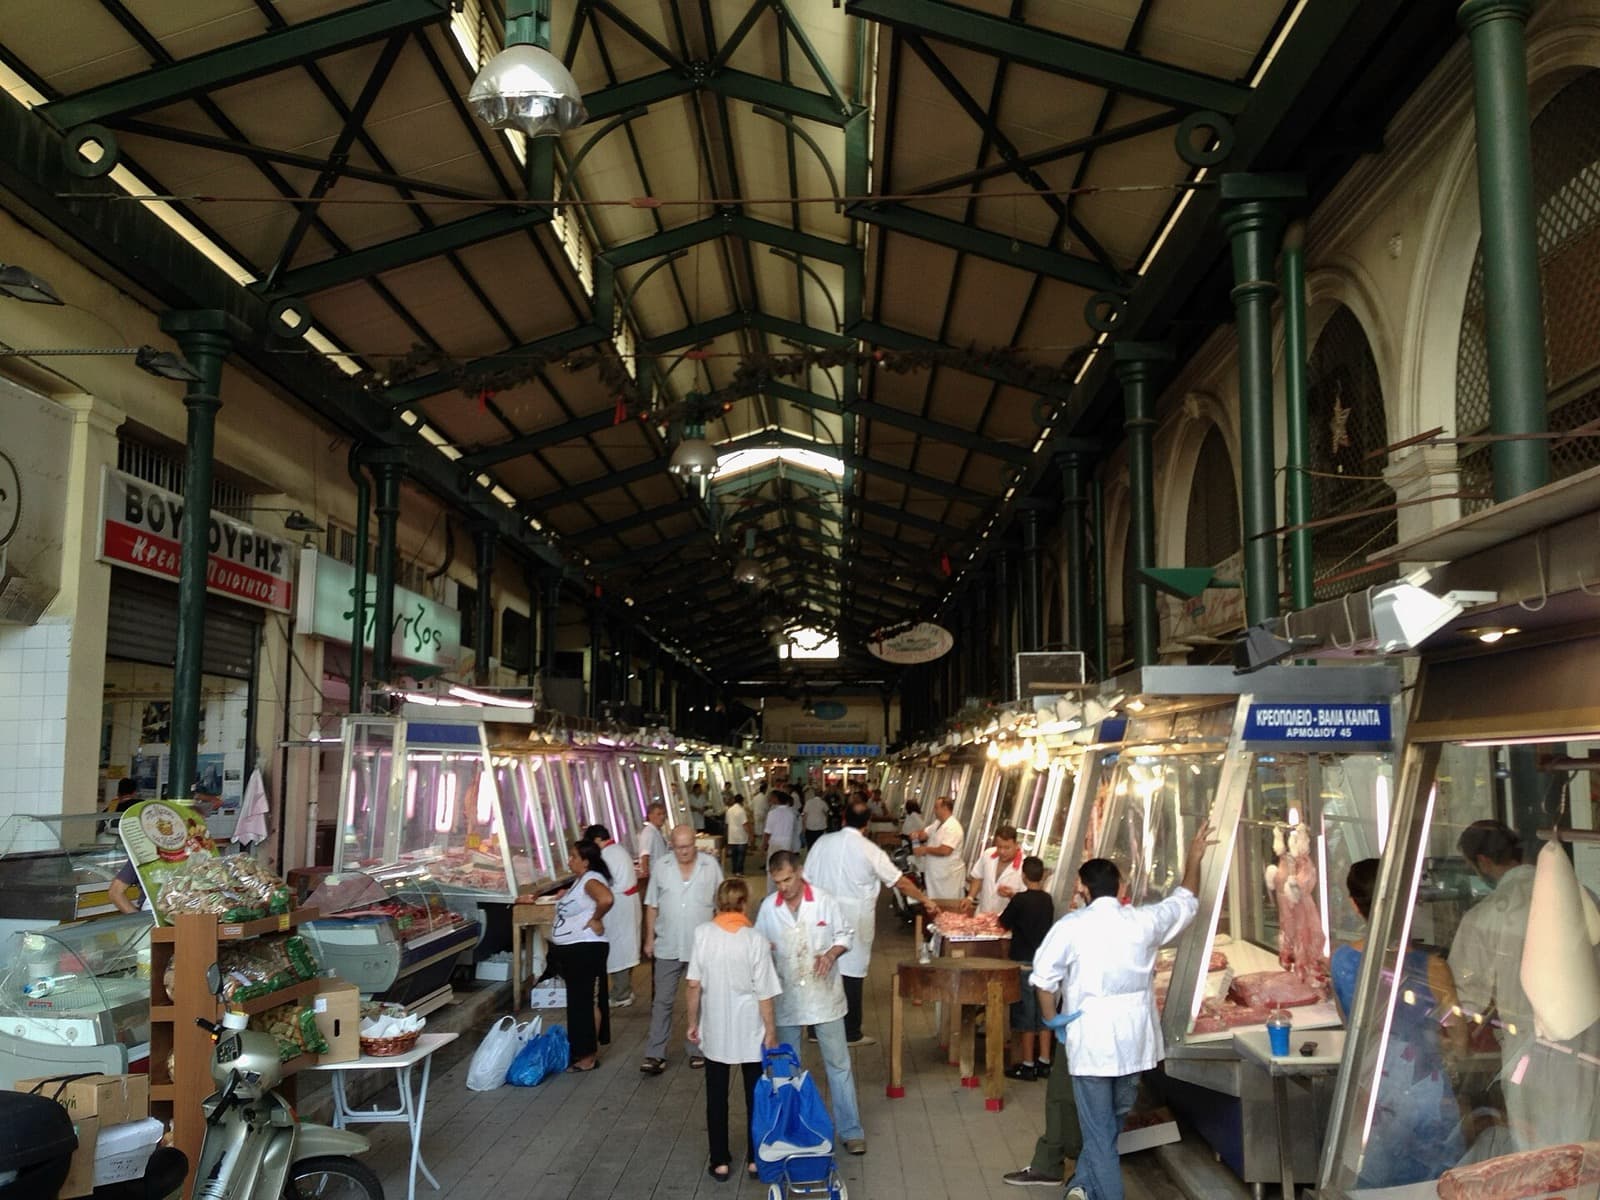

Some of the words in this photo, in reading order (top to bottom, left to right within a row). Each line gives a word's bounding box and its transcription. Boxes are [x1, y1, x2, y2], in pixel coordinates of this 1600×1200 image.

[125, 483, 283, 575] ΒΟΥΟΥΡΗΣ
[1256, 709, 1312, 726] ΚΡΕΟΠΩΛΕΙΟ
[1286, 728, 1336, 737] ΑΡΜΟΔΙΟΥ
[1340, 728, 1352, 737] 45
